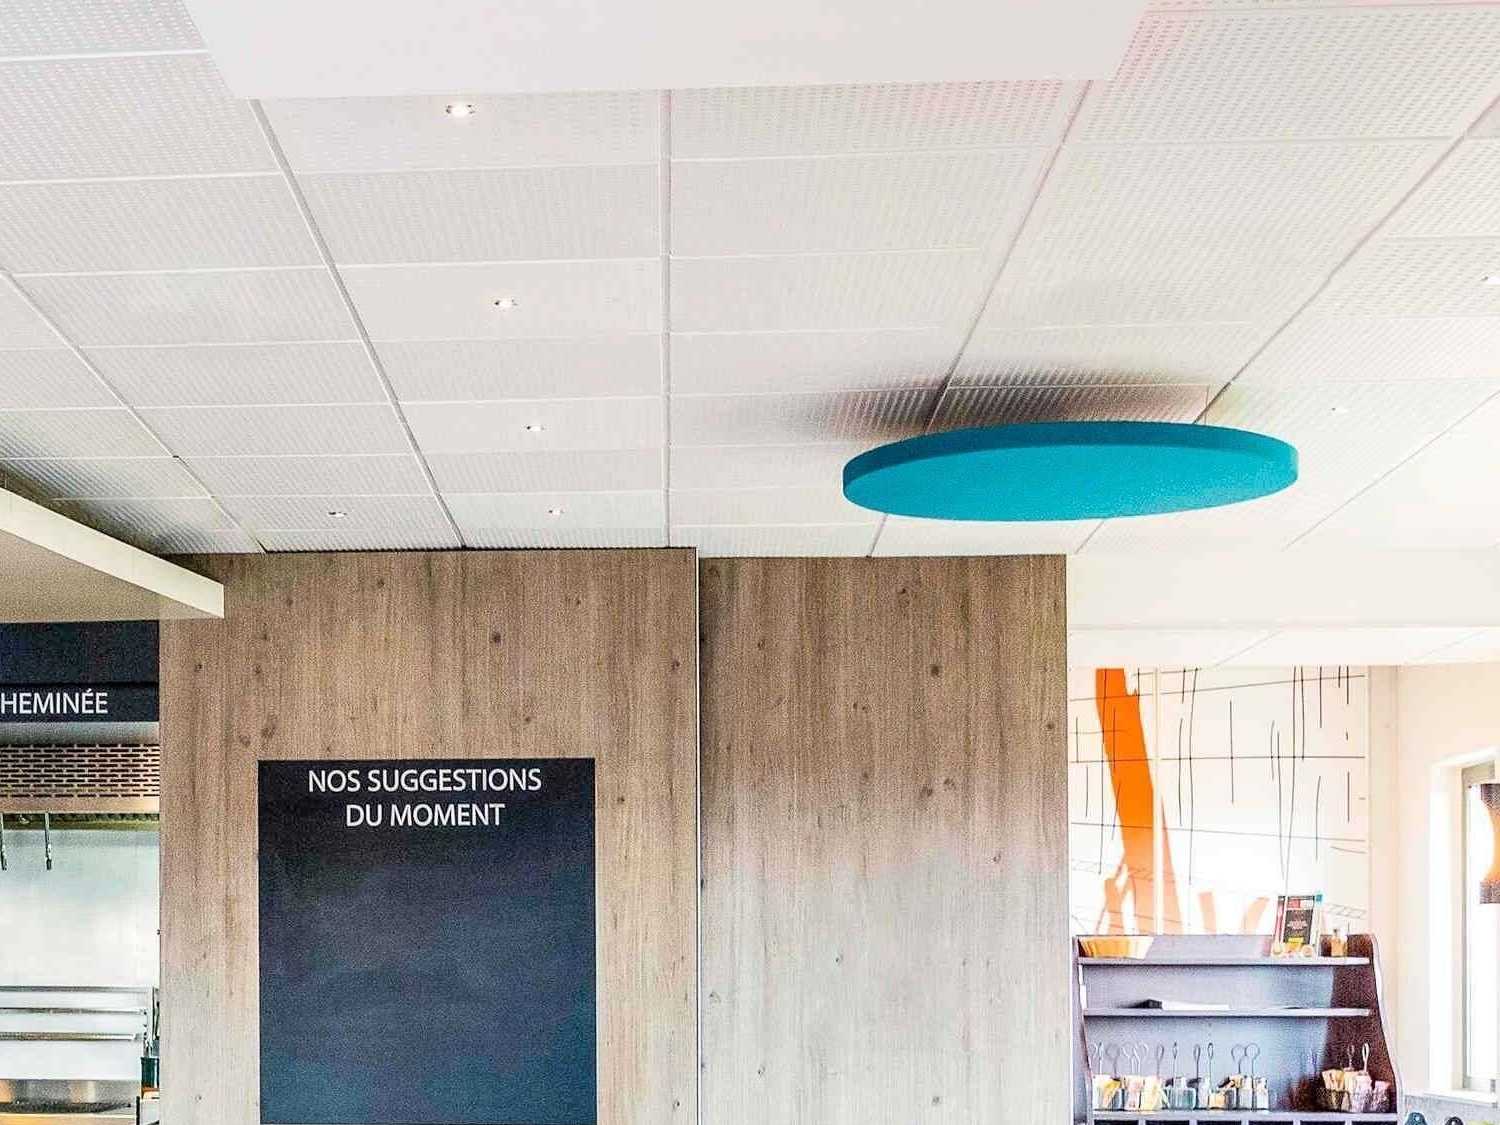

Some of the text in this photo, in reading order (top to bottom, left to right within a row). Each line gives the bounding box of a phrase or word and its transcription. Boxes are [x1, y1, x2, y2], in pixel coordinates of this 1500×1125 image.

[308, 768, 542, 793] NOS SUGGESTIONS
[346, 803, 506, 827] DU MOMENT
